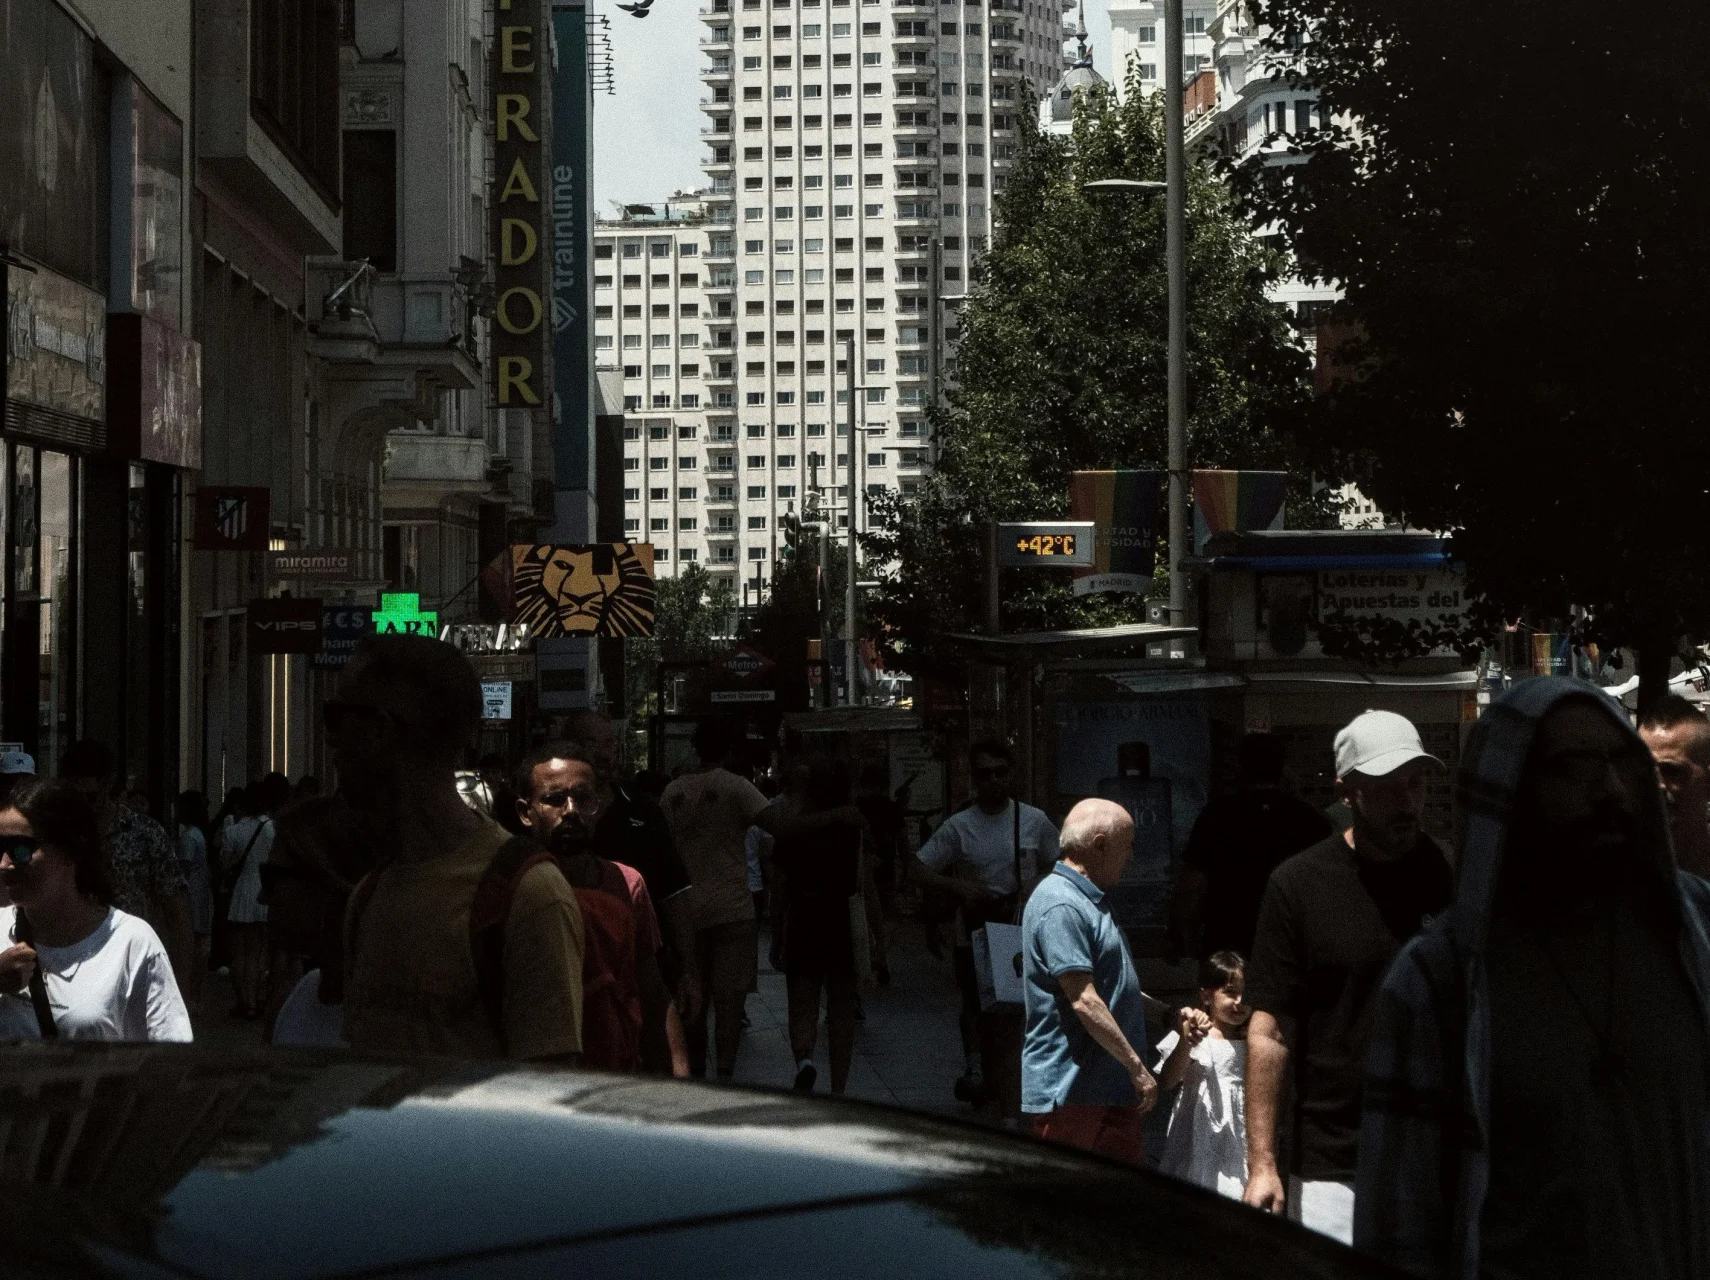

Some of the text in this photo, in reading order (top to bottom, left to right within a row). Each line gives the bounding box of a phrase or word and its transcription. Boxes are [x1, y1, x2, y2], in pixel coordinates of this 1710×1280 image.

[553, 164, 574, 290] trainline
[275, 556, 348, 568] miramira
[1098, 578, 1132, 587] MADRID
[1415, 574, 1427, 591] y
[1323, 591, 1459, 610] Apuestas del
[254, 620, 316, 631] VIPS
[728, 660, 757, 669] Metro
